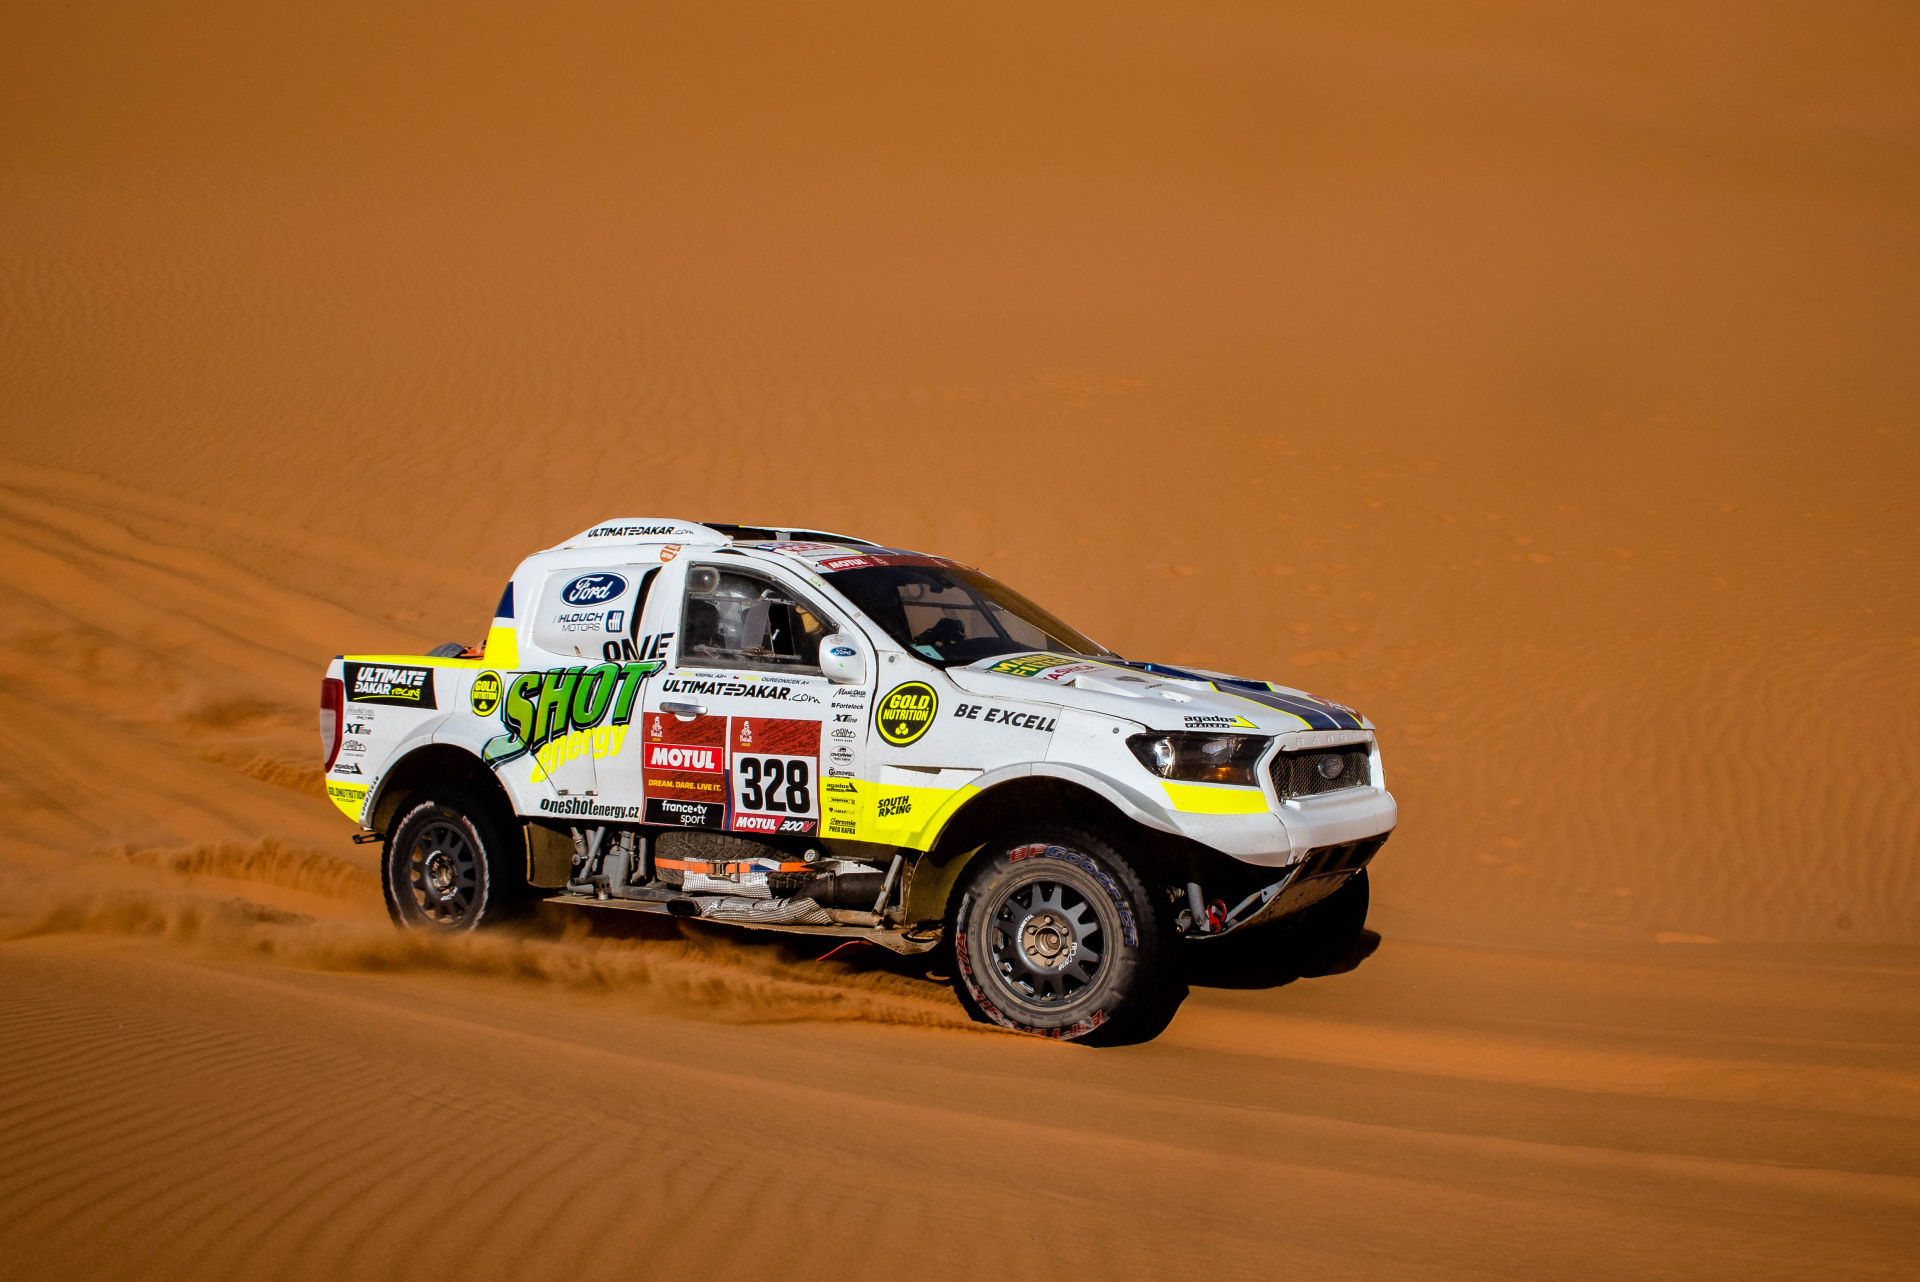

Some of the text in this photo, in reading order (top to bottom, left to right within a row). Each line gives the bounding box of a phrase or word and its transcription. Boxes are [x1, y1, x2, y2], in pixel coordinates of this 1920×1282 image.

[830, 558, 868, 569] MOTUL
[569, 576, 611, 602] Ford
[559, 612, 605, 624] HLOUCH
[561, 623, 601, 632] MOTORS
[603, 632, 675, 661] ONE
[356, 666, 427, 687] ULTIMATE
[353, 682, 422, 699] DAKAR racing
[836, 702, 865, 710] Fortelock
[482, 660, 667, 772] SHOT
[833, 713, 858, 723] XTline
[883, 708, 928, 722] NUTRITION
[953, 703, 1057, 733] BE EXCELL
[1183, 715, 1237, 723] agados
[344, 722, 372, 735] XTline
[530, 724, 629, 784] energy
[651, 746, 715, 770] MOTUL
[648, 778, 722, 792] DREAM. DARE. LIVE IT.
[739, 757, 811, 814] 328
[540, 796, 640, 819] oneshotenergy.cz
[877, 795, 910, 809] SOUTH
[878, 803, 912, 818] RACING
[680, 813, 706, 826] sport
[735, 815, 816, 833] MOTUL 300V
[1009, 844, 1138, 949] BFGoodrich
